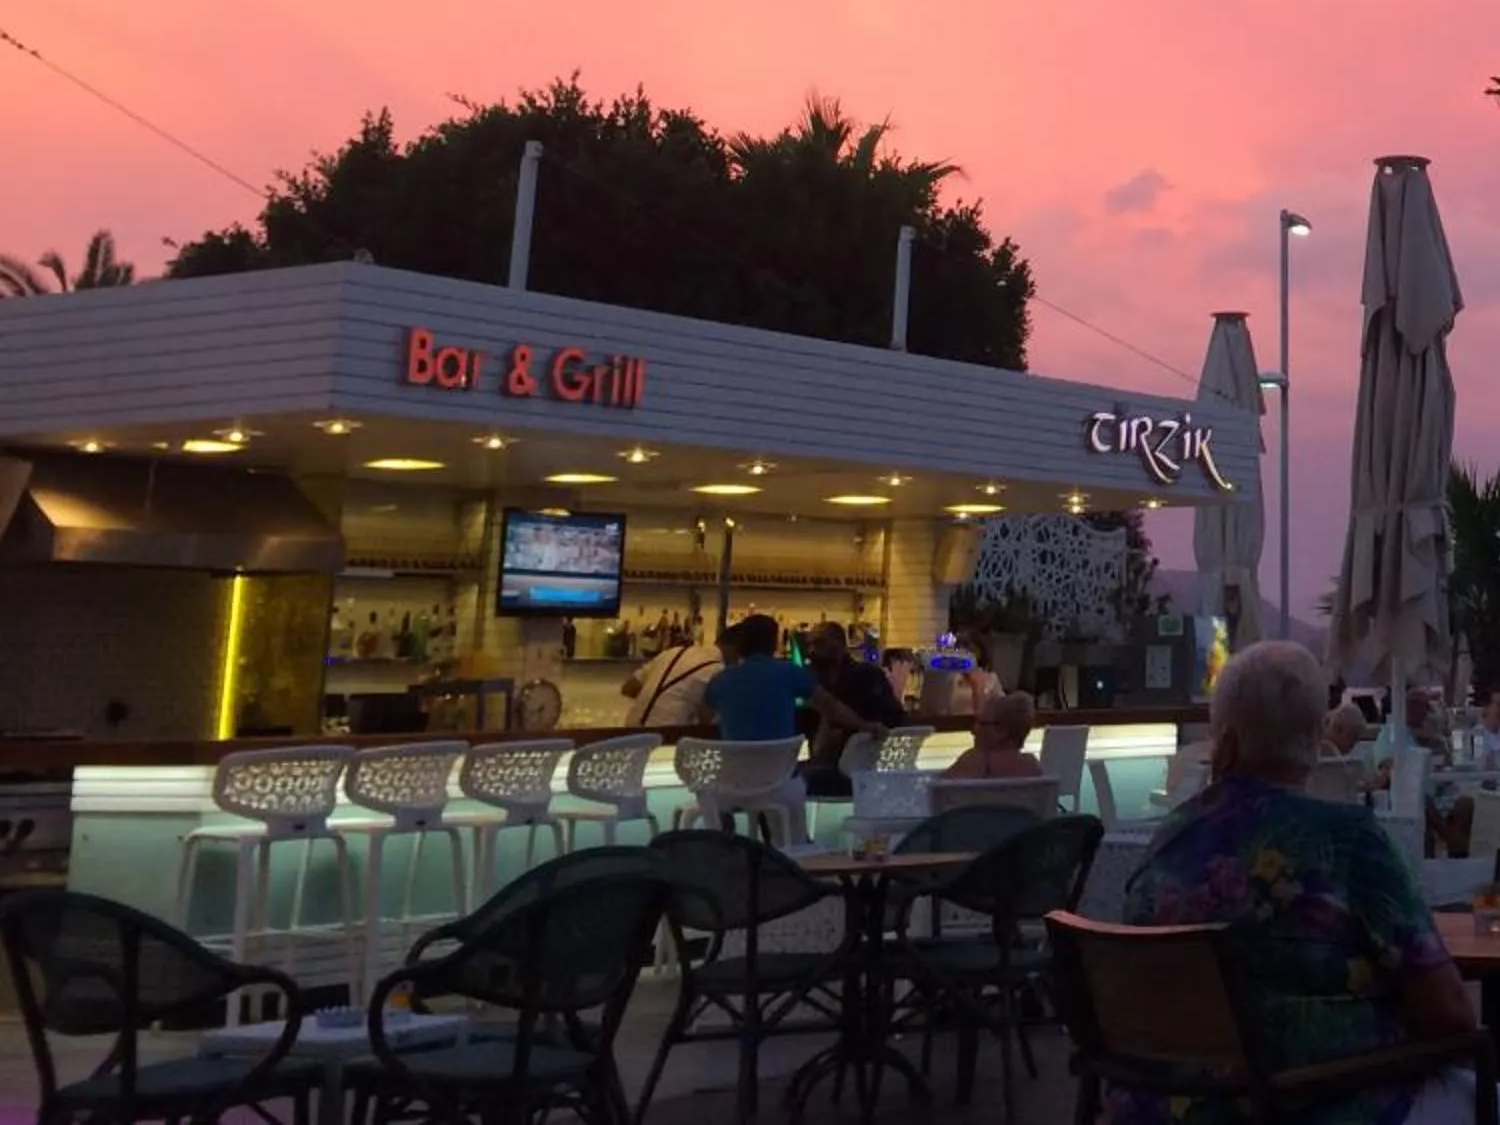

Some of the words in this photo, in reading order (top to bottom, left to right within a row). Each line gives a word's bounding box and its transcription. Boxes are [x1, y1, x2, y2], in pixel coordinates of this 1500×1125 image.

[408, 327, 485, 389] Bar
[508, 343, 538, 395] &
[552, 346, 645, 406] Grill
